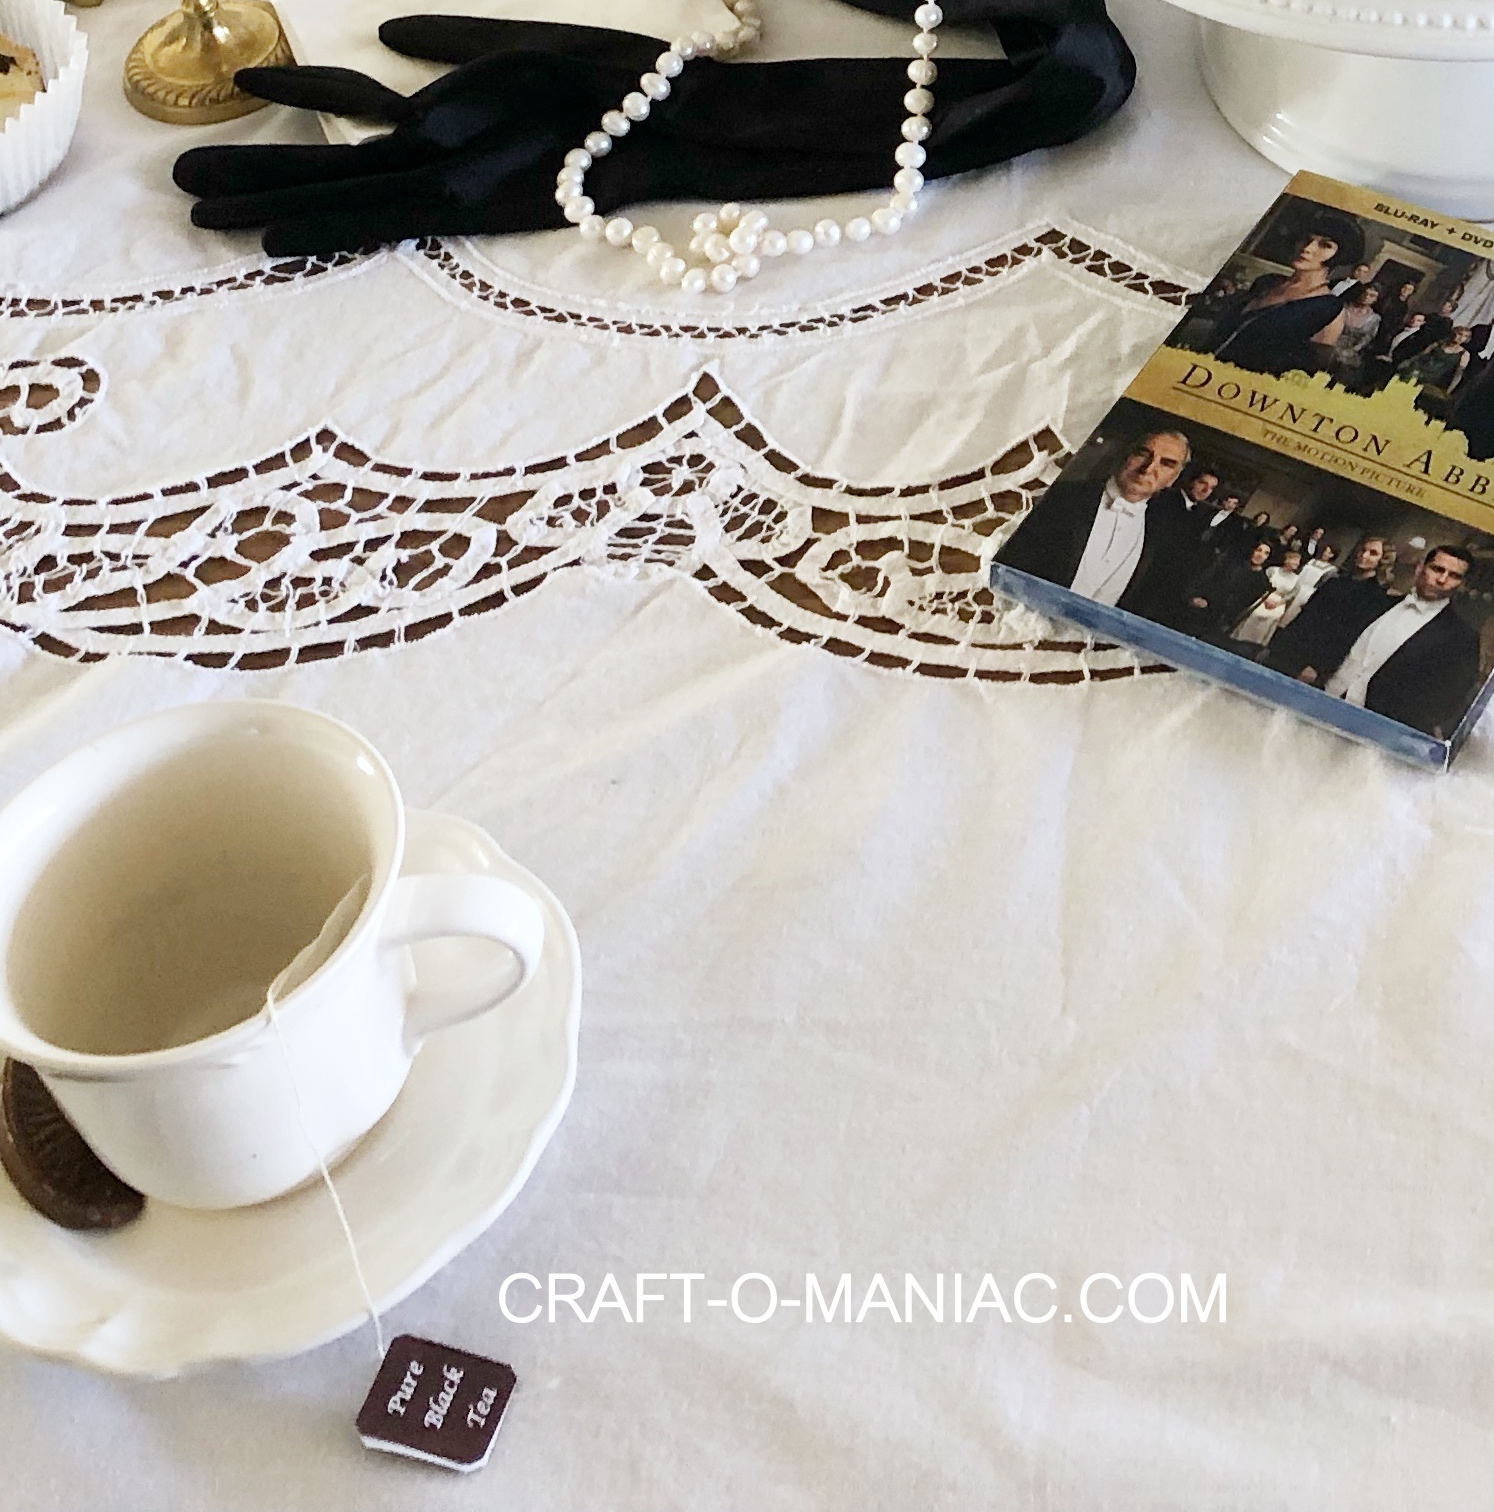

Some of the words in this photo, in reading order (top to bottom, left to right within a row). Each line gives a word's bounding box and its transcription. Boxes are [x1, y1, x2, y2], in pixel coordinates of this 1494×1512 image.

[1373, 201, 1440, 230] BLU-RAY
[1177, 362, 1392, 456] DOWNTON
[1262, 429, 1292, 448] THE
[1293, 441, 1357, 475] MOTION
[1359, 466, 1426, 499] PICTURE
[387, 1360, 425, 1418] Pure
[423, 1363, 465, 1430] Black
[466, 1386, 498, 1429] Tea
